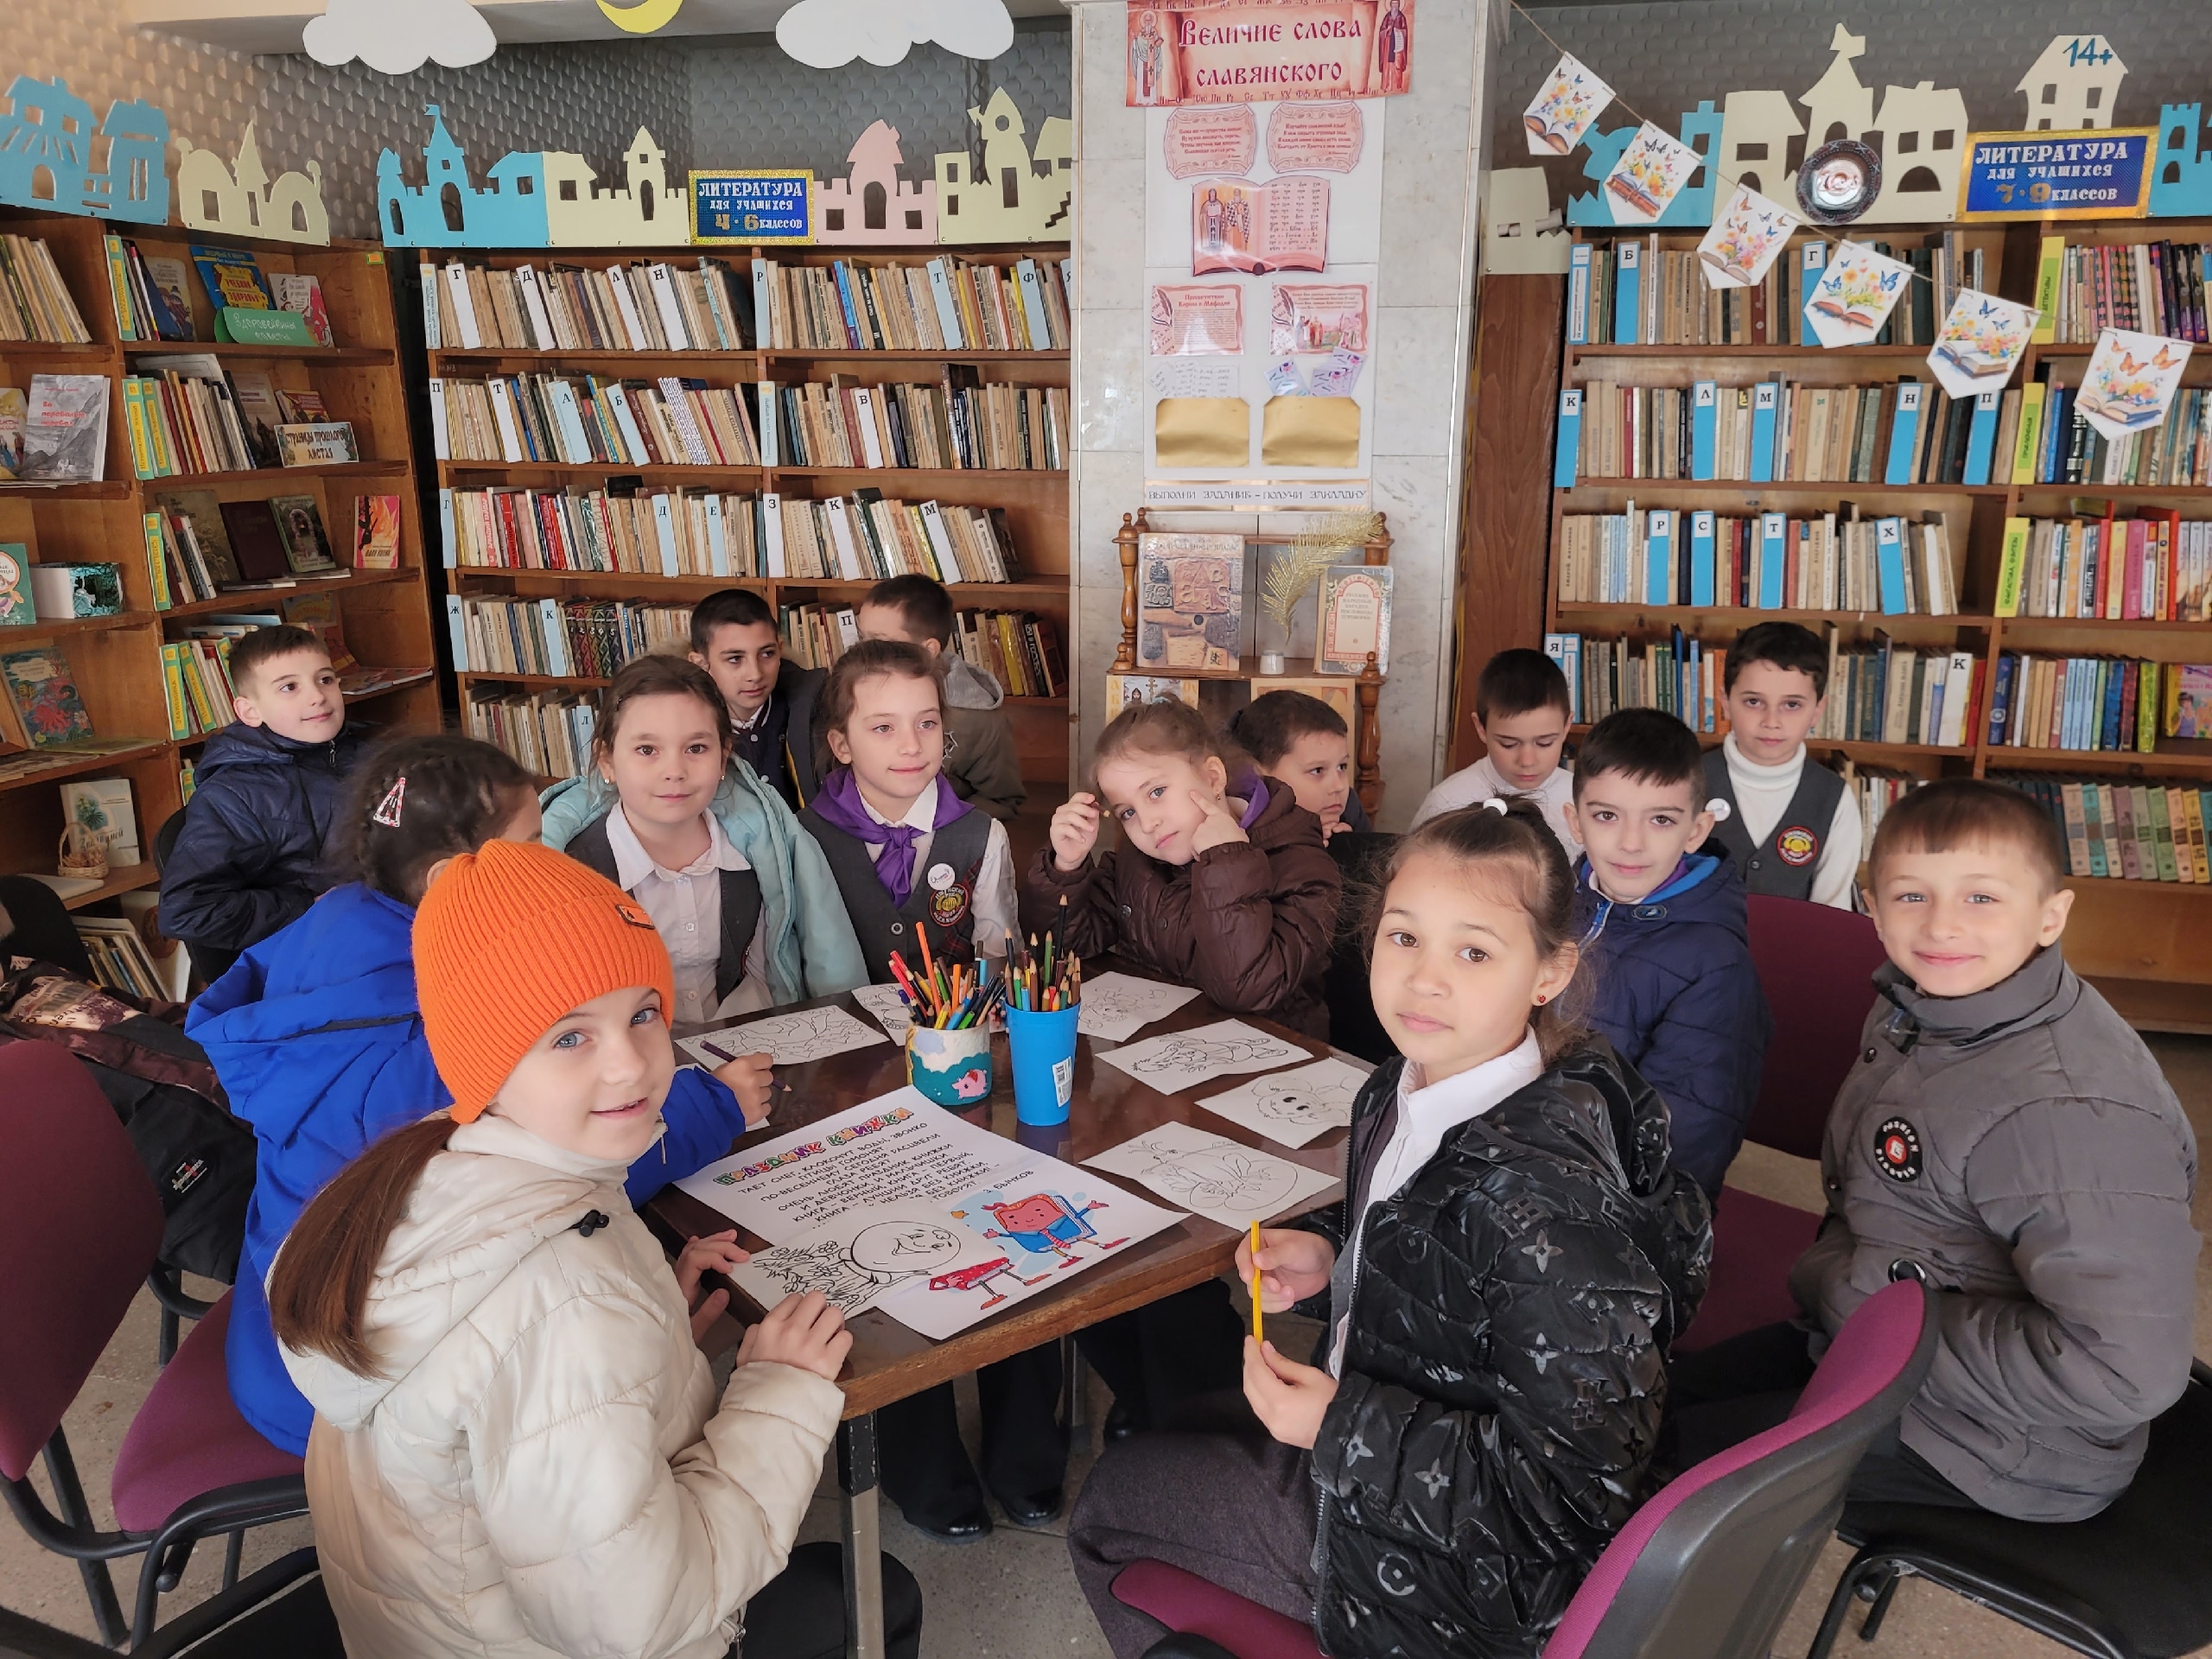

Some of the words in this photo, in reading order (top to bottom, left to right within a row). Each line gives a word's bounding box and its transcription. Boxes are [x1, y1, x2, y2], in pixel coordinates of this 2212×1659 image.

[2063, 38, 2113, 67] 14+
[1975, 142, 2127, 164] ЛИТЕРАТУРА
[698, 182, 803, 197] ЛИТЕРАТУРА
[1148, 491, 1196, 499] ВЫПОЛНИ
[1263, 491, 1303, 499] ПОЛУЧИ
[1310, 491, 1367, 499] ЗАКЛАДКУ
[713, 1141, 826, 1185] ПРАЗДНИК
[826, 1108, 914, 1146] КНИЖКИ
[738, 1181, 766, 1194] ТАЕТ
[802, 1149, 854, 1172] КЛОКОЧУТ
[857, 1138, 891, 1152] ВОДЫ,
[891, 1122, 928, 1140] ЗВОНКО
[760, 1169, 841, 1202] ПО-ВЕСЕННЕМУ
[844, 1154, 889, 1172] СЕГОДНЯ
[891, 1133, 941, 1154] РАСЦВЕЛИ
[778, 1196, 815, 1211] ОЧЕНЬ
[818, 1179, 855, 1197] ЛЮБЯТ
[859, 1160, 911, 1181] ПРАЗДНИК
[912, 1143, 954, 1161] КНИЖКИ
[798, 1163, 837, 1181] ПТИЦЫ
[826, 1172, 859, 1185] ГЛАЗА
[994, 1170, 1034, 1190] БЫЧКОВ
[792, 1206, 829, 1223] КНИГА
[887, 1170, 919, 1185] КНИГА
[816, 1205, 850, 1222] КНИГА
[862, 1184, 908, 1204] ЛУЧШИЙ
[910, 1173, 933, 1185] ДРУГ
[880, 1187, 921, 1205] НЕЛЬЗЯ
[922, 1179, 943, 1189] БЕЗ
[925, 1185, 946, 1195] БЕЗ
